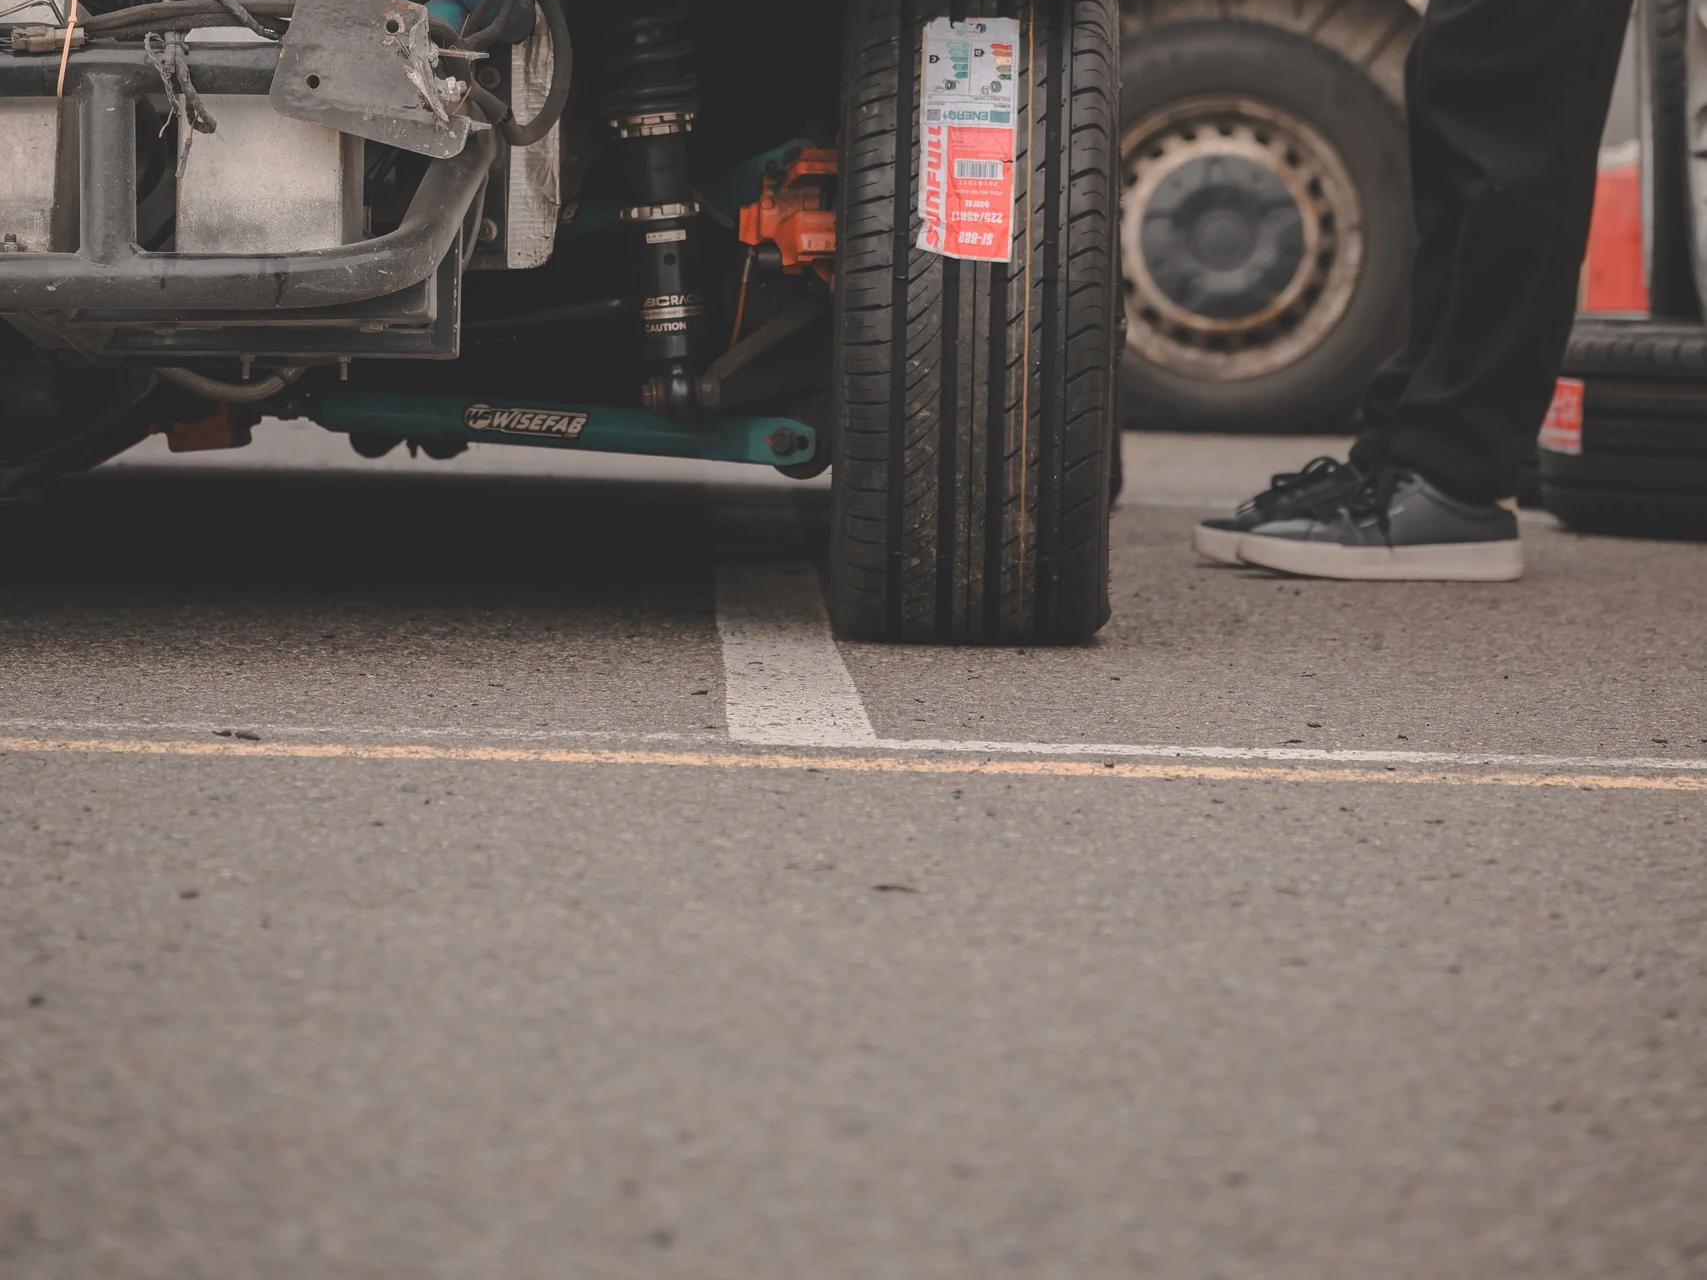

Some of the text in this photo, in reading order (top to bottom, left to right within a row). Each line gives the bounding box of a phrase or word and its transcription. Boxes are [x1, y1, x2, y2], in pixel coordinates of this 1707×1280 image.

[948, 110, 989, 121] ENERG
[926, 125, 942, 249] SUNFULL
[952, 211, 1004, 223] 225/45R17
[645, 321, 687, 333] CAUTION
[492, 411, 587, 434] WISEFAB
